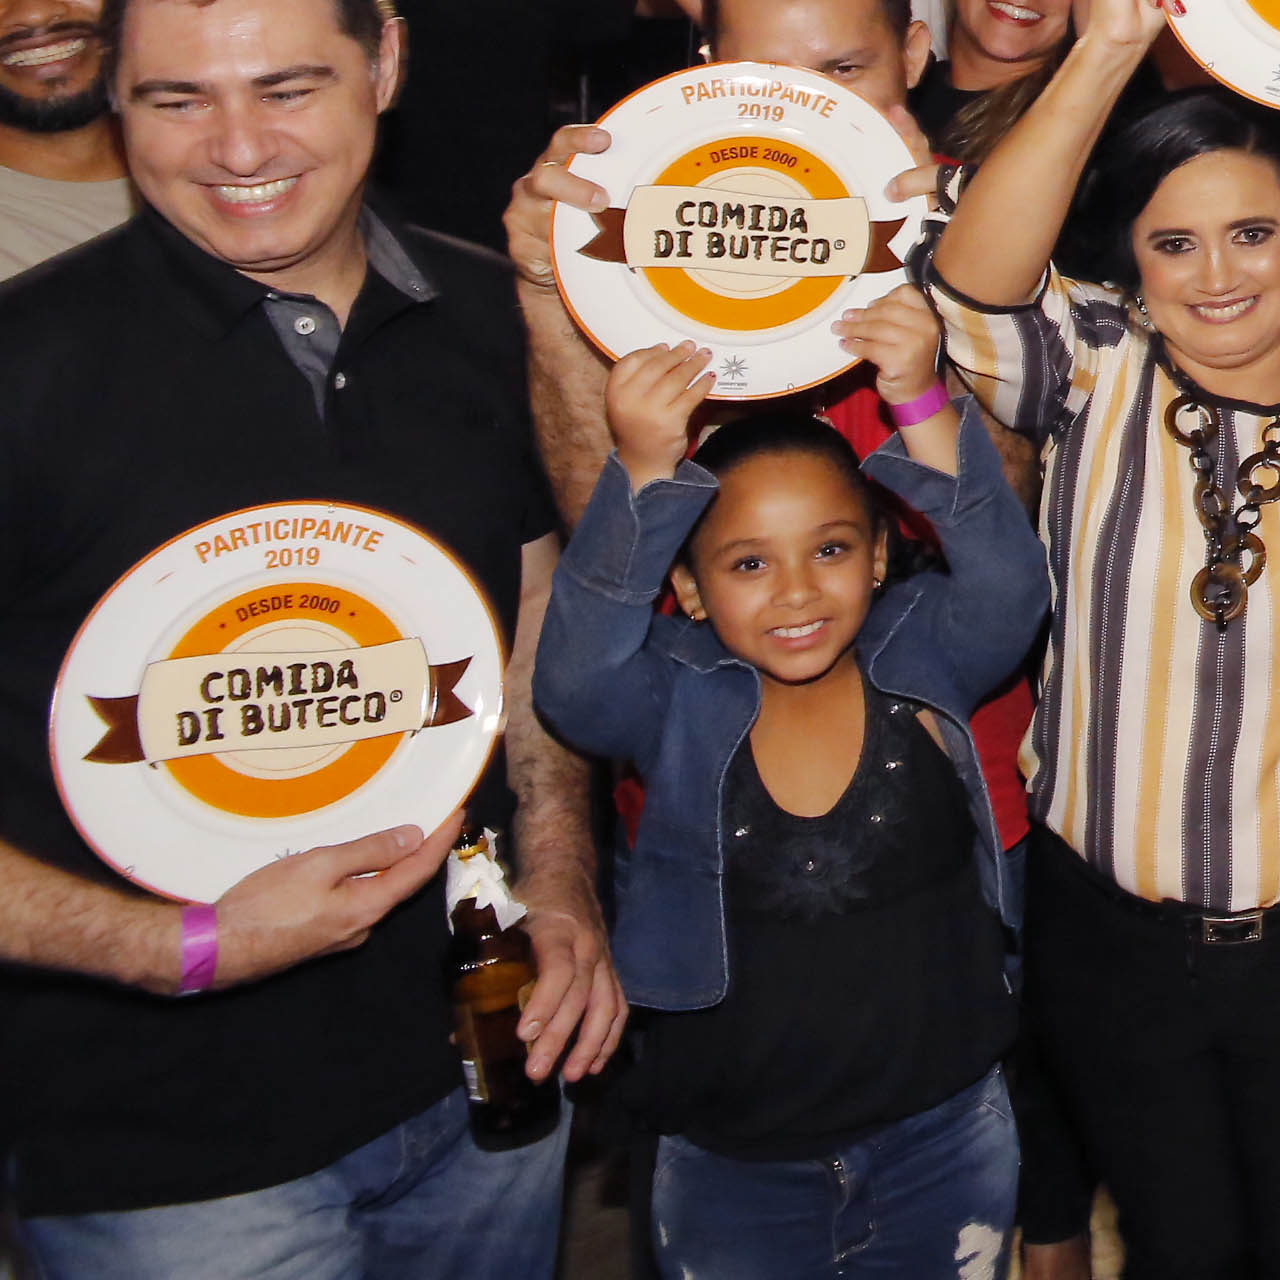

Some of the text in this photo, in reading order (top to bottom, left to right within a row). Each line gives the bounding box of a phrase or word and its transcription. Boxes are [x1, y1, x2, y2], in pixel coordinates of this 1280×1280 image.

[680, 79, 838, 118] PARTICIPANTE
[737, 103, 784, 122] 2019
[710, 146, 798, 168] DESDE 2000
[675, 201, 808, 233] COMIDA
[653, 230, 693, 258] DI
[194, 518, 385, 564] PARTICIPANTE
[265, 546, 321, 570] 2019
[235, 594, 341, 622] DESDE 2000
[199, 659, 359, 705] COMIDA
[176, 707, 225, 746] DI
